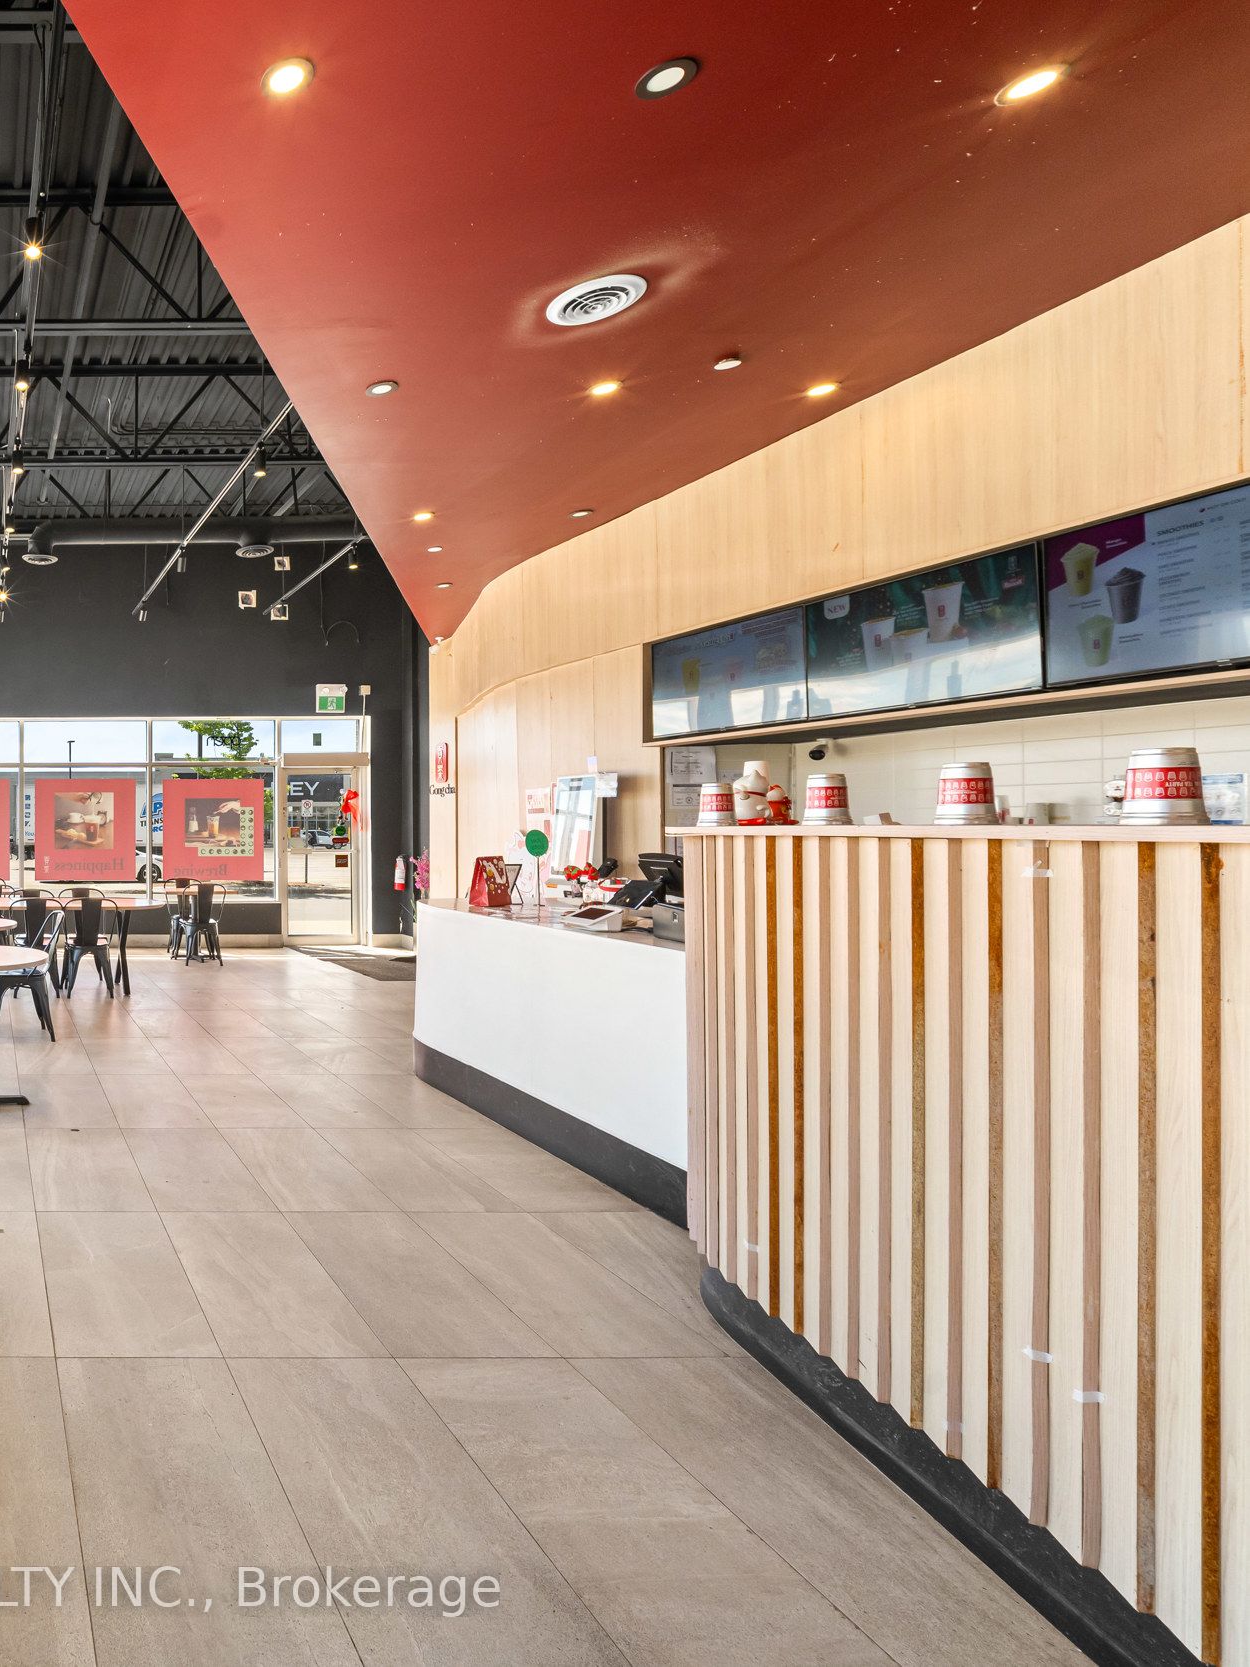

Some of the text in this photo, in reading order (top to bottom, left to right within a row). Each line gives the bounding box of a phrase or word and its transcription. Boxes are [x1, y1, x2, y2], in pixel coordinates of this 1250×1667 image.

[1156, 520, 1205, 537] SMOOTHIES
[827, 603, 846, 614] NEW
[286, 781, 320, 796] EY
